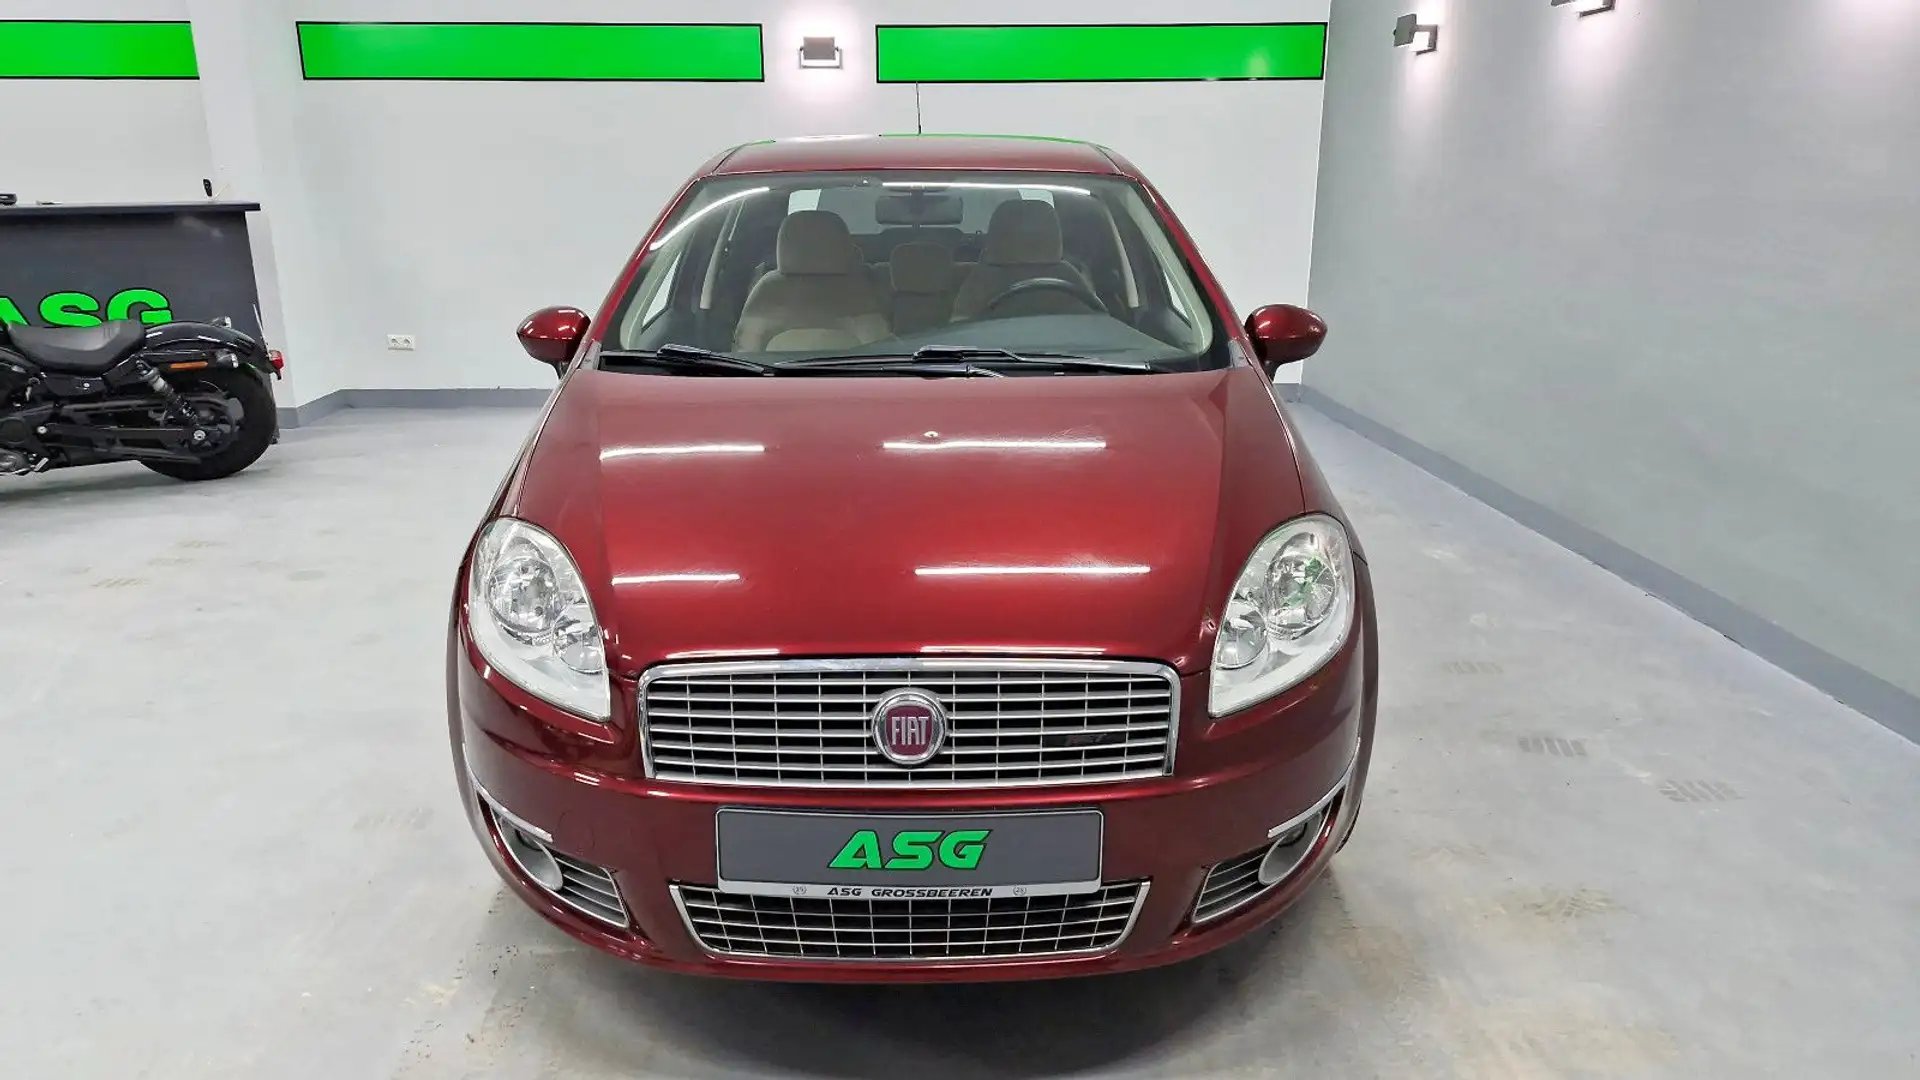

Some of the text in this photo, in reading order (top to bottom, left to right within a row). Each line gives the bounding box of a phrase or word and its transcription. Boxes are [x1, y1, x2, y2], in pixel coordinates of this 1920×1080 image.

[891, 716, 930, 746] FIAT
[827, 829, 993, 870] ASG
[827, 887, 993, 898] ASG GROSSBEEREN
